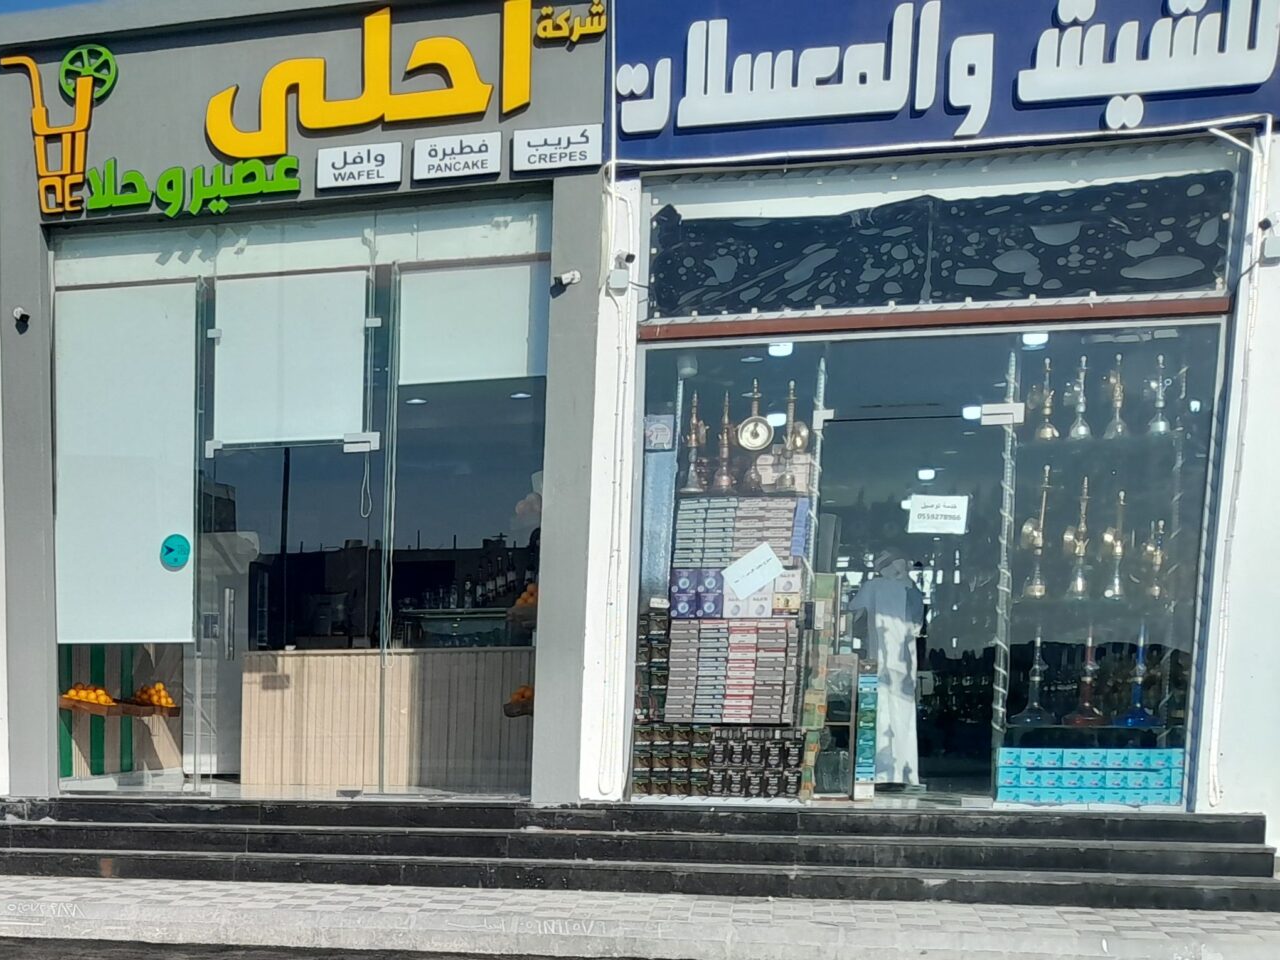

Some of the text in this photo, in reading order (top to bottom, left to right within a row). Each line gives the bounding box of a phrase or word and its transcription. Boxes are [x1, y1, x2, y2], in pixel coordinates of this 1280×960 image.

[536, 0, 608, 46] شركة
[427, 138, 490, 161] فطيرة
[526, 128, 590, 150] كريب
[331, 150, 386, 170] وافل
[427, 158, 489, 174] PANCAKE
[527, 150, 589, 165] CREPES
[188, 155, 301, 216] عصير
[332, 169, 385, 183] WAFEL
